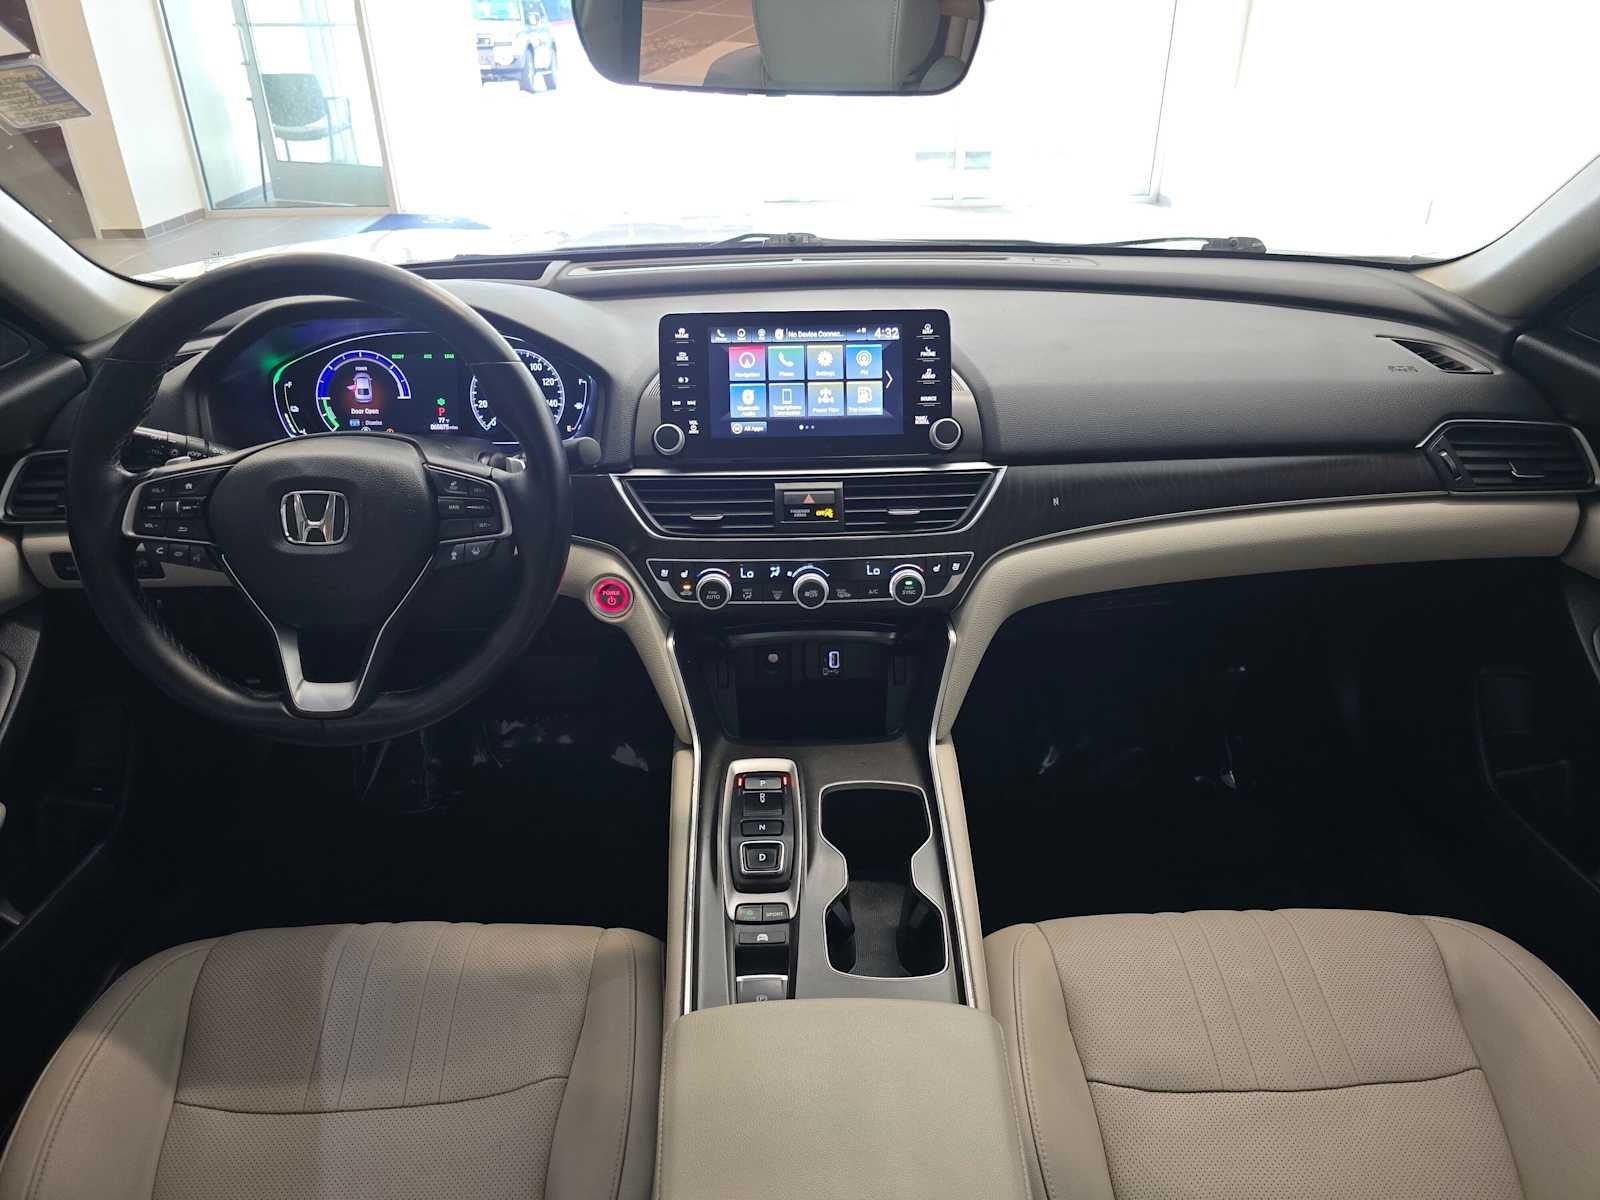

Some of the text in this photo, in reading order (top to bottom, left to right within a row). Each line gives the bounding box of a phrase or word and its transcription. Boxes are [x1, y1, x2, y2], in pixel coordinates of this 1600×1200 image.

[874, 328, 900, 339] 4:32
[543, 378, 554, 386] 120
[478, 400, 488, 408] 20
[438, 407, 446, 416] P
[740, 568, 754, 578] Lo
[866, 564, 881, 576] Lo
[758, 853, 767, 862] D
